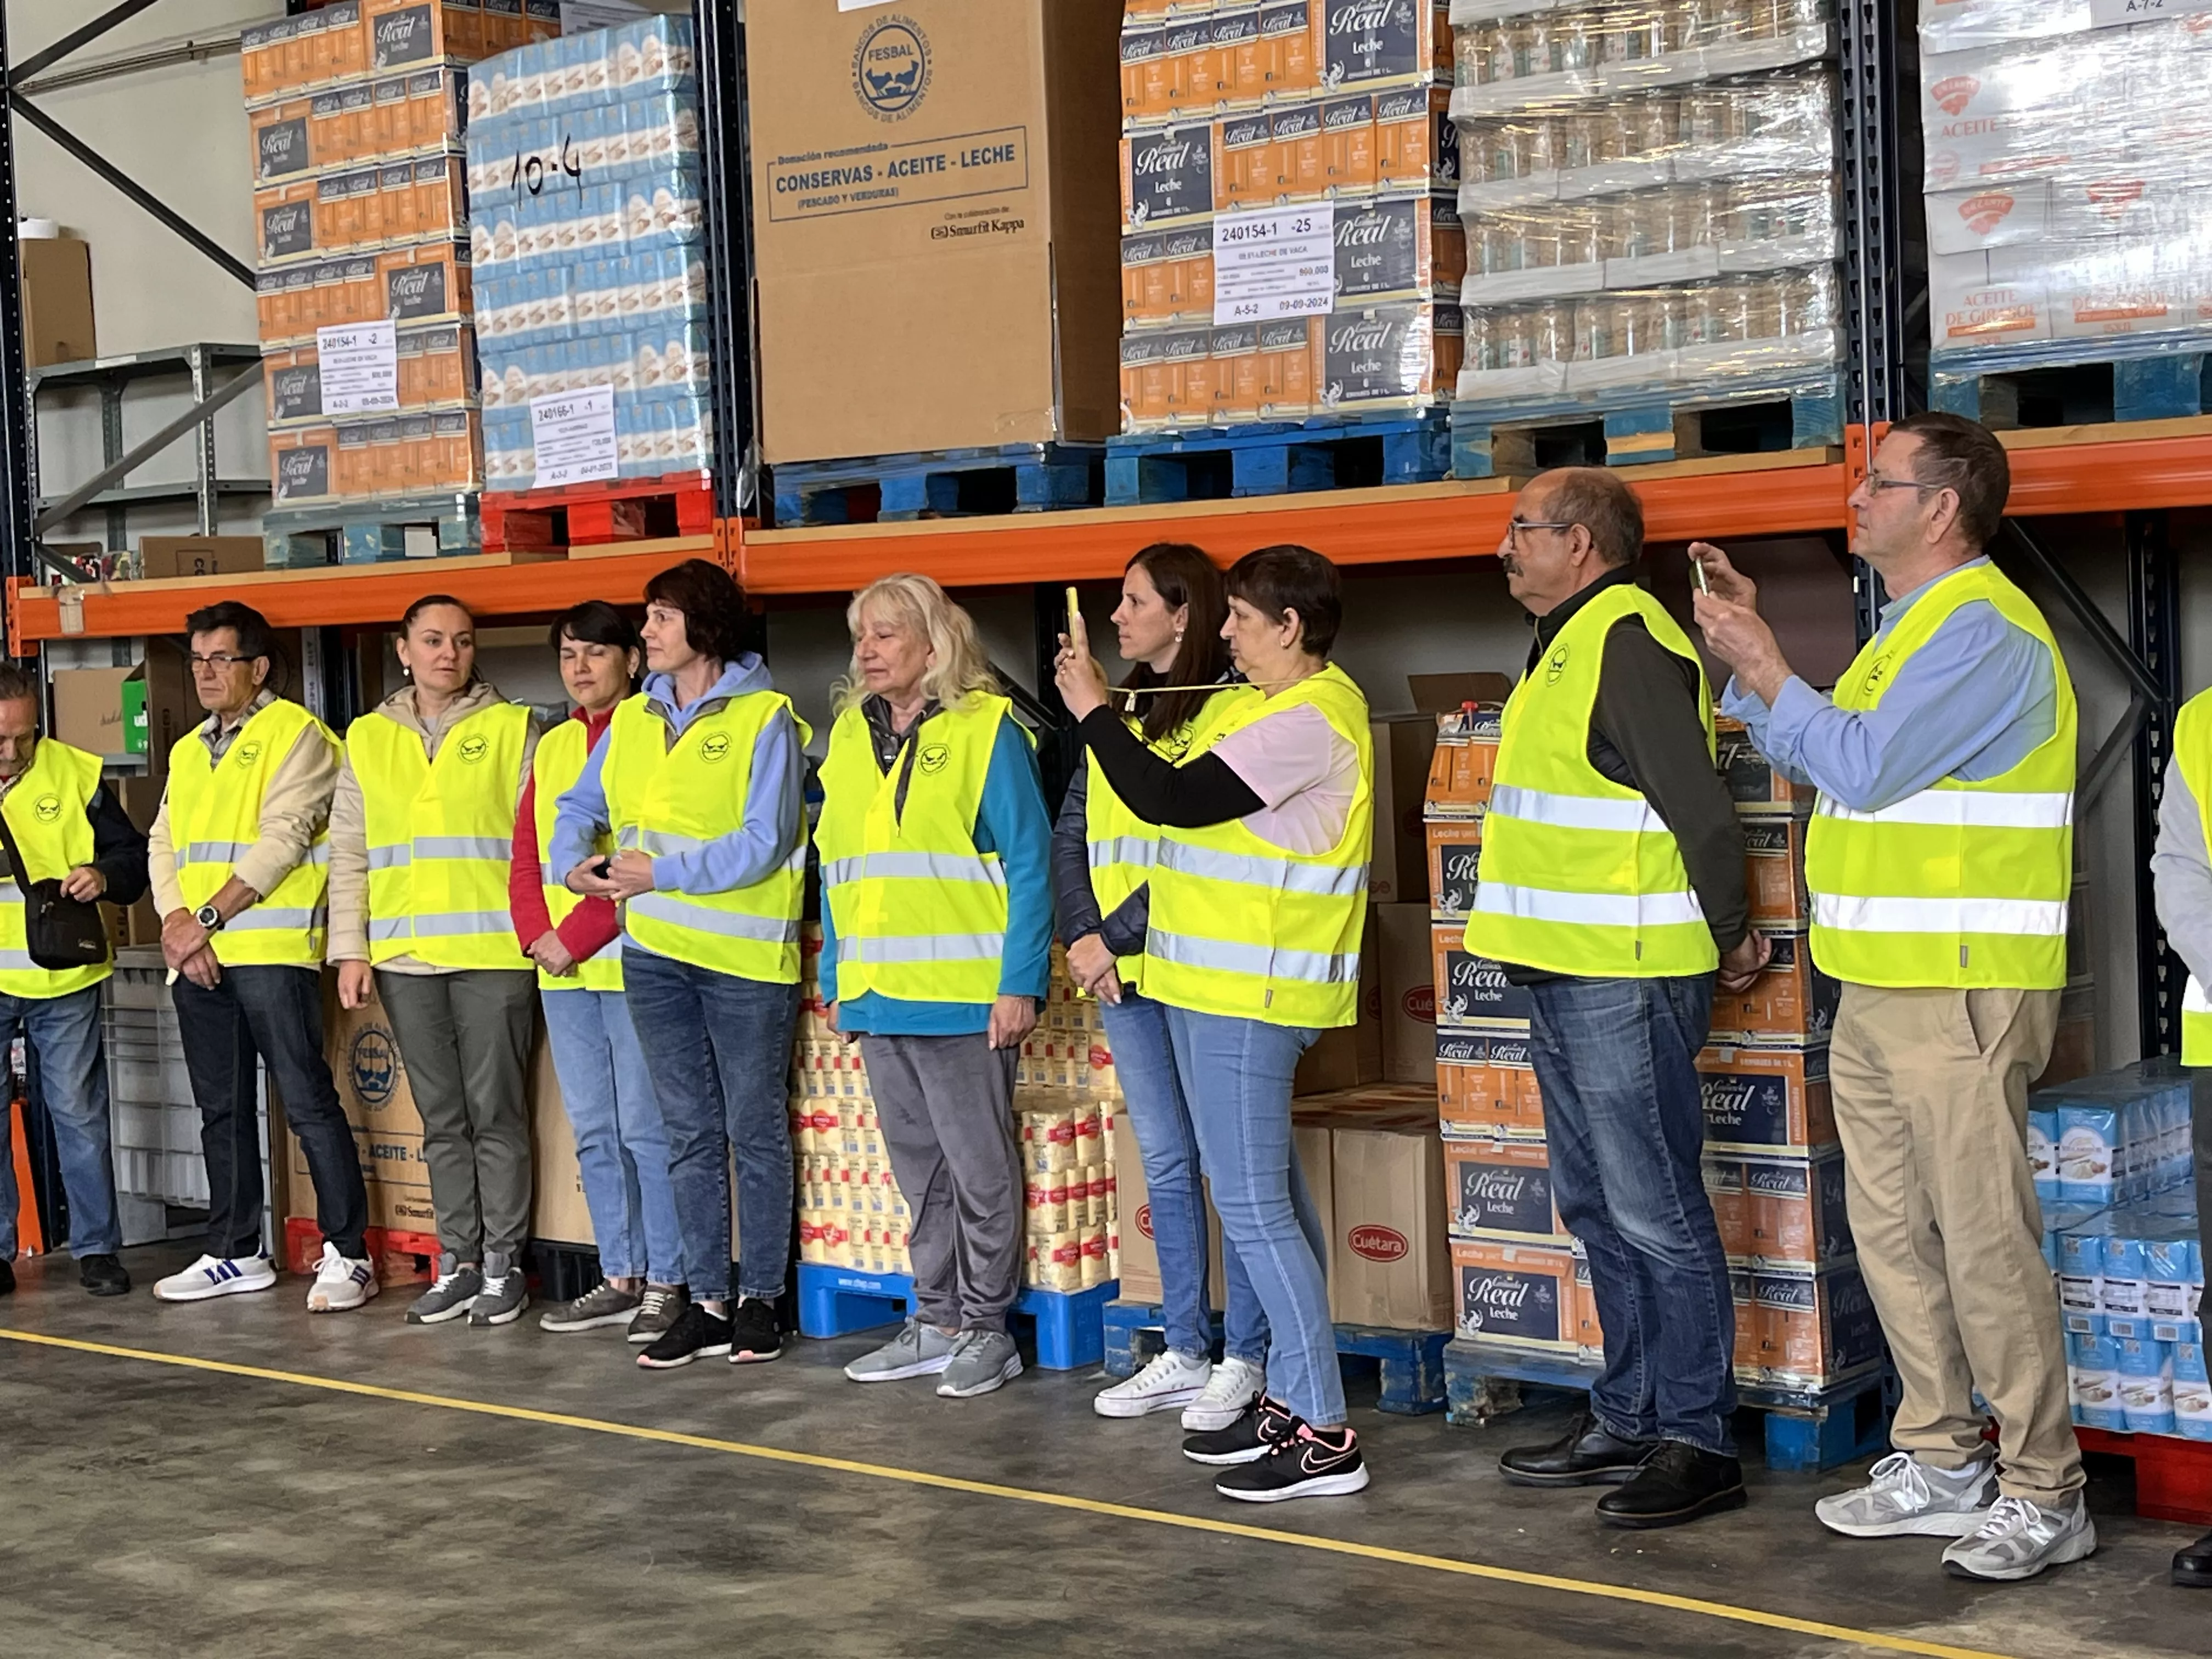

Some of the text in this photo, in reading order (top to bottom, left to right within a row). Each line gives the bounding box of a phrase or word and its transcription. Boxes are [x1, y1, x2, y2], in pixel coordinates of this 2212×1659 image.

[1329, 0, 1393, 35] Real
[377, 16, 416, 43] Real
[851, 14, 932, 69] BANCOS DE ALIMENTOS
[1353, 38, 1384, 54] Leche
[868, 43, 914, 62] FESBAL
[881, 113, 894, 123] DE
[896, 69, 933, 122] ALIMENTOS
[1942, 117, 1997, 138] ACEITE
[262, 129, 292, 155] Real
[778, 142, 888, 165] Donación recomendada
[1135, 142, 1190, 176] Real
[776, 165, 873, 193] CONSERVAS
[887, 154, 946, 178] ACEITE
[961, 144, 1015, 168] LECHE
[1155, 178, 1182, 193] Leche
[842, 194, 848, 203] Y
[266, 210, 298, 234] Real
[949, 219, 1024, 238] Smurfit Kappa
[1335, 216, 1391, 247] Real
[1222, 222, 1277, 242] 240154-1
[1351, 253, 1382, 268] Leche
[391, 271, 428, 297] Real
[1964, 290, 2017, 307] ACEITE
[1945, 312, 1965, 326] DE
[1329, 321, 1392, 354] Real
[1351, 358, 1381, 374] Leche
[1438, 934, 1464, 944] Lech
[1452, 961, 1510, 988] Rea
[1475, 989, 1503, 1002] Leche
[1439, 1042, 1474, 1059] Real
[1490, 1045, 1527, 1061] Real
[369, 1144, 407, 1161] ACEITE
[1465, 1172, 1525, 1201] Real
[1751, 1171, 1790, 1190] Real
[1487, 1201, 1514, 1215] Leche
[1352, 1233, 1402, 1252] Cuétara
[1468, 1277, 1529, 1307] Real
[1759, 1284, 1798, 1303] Real
[1489, 1306, 1519, 1321] Leche
